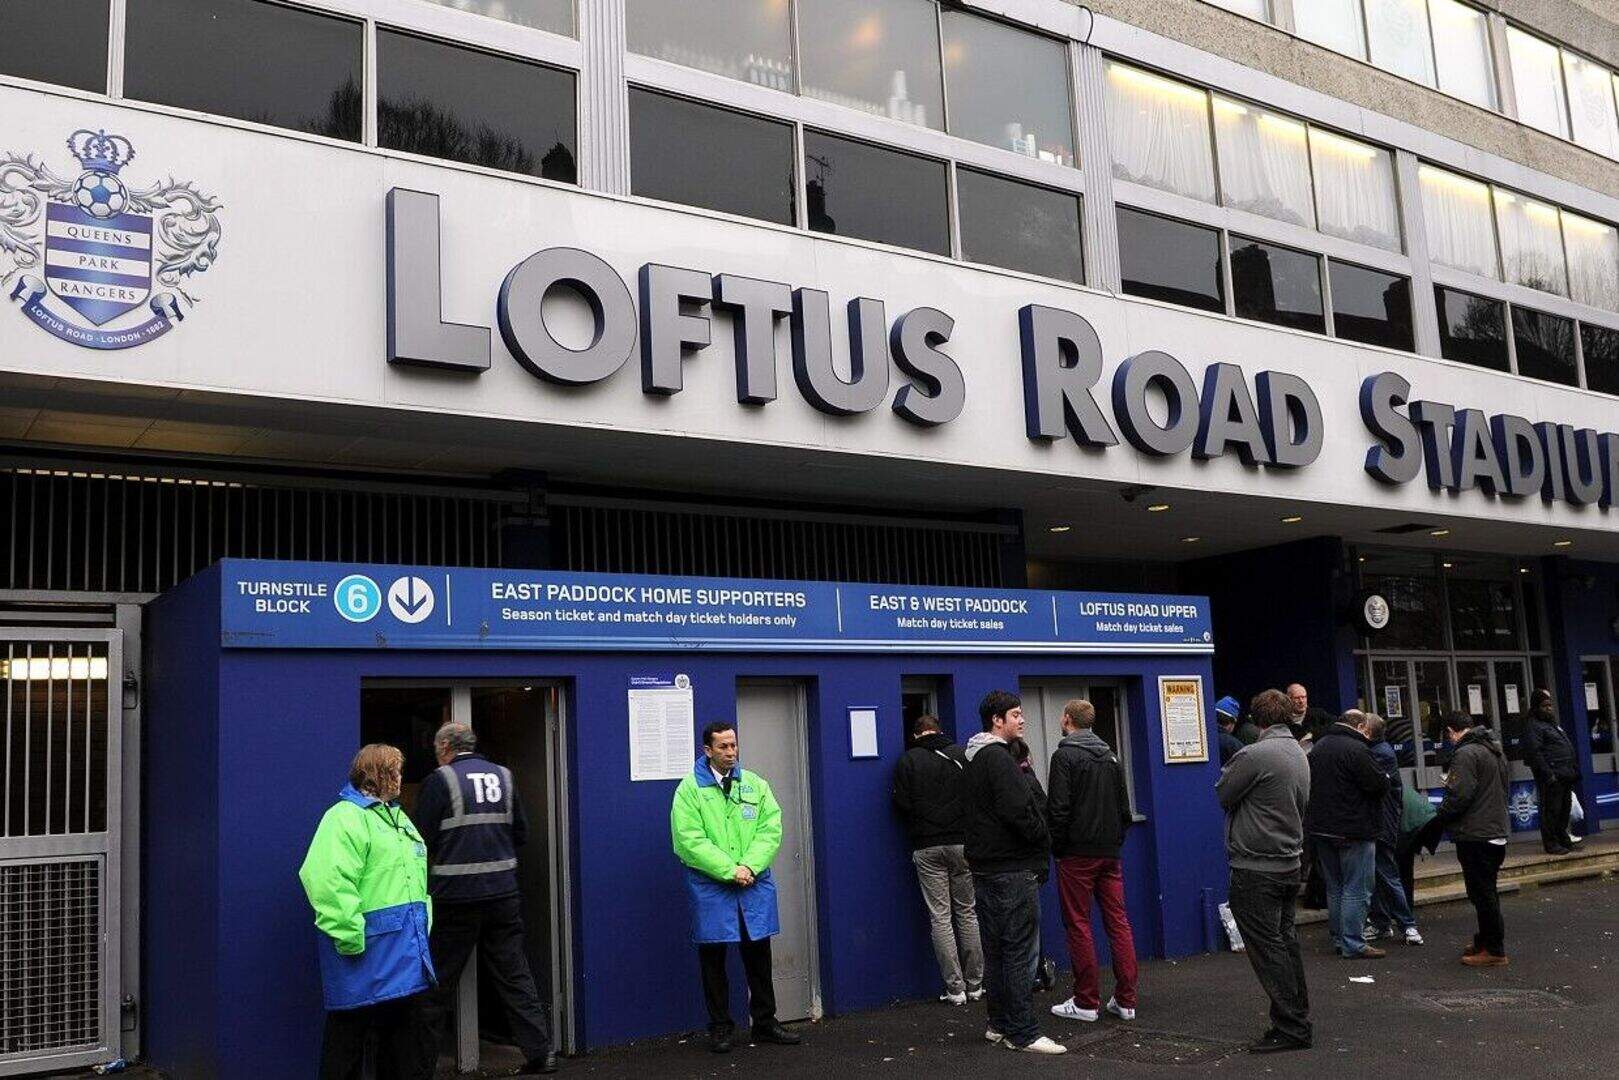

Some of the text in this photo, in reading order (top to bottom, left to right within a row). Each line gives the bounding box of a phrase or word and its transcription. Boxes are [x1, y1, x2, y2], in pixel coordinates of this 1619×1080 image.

[67, 226, 133, 245] QUEENS
[79, 255, 120, 271] PARK
[60, 282, 136, 301] RANGERS
[31, 305, 64, 332] LOFTUS
[66, 328, 94, 342] ROAD
[101, 332, 141, 344] LONDON
[386, 186, 966, 427] LOFTUS
[1018, 303, 1324, 469] ROAD
[237, 581, 328, 597] TURNSTILE
[491, 582, 807, 608] EAST PADDOCK HOME SUPPORTERS
[255, 600, 311, 614] BLOCK
[347, 584, 369, 614] 6
[869, 594, 1028, 614] EAST & WEST PADDOCK
[501, 608, 797, 628] Season ticket and match day ticket holders only
[1080, 602, 1198, 618] LOFTUS ROAD UPPER
[897, 617, 1004, 631] Match day ticket sales
[1096, 621, 1184, 634] Match day ticket sales
[467, 772, 502, 804] T8
